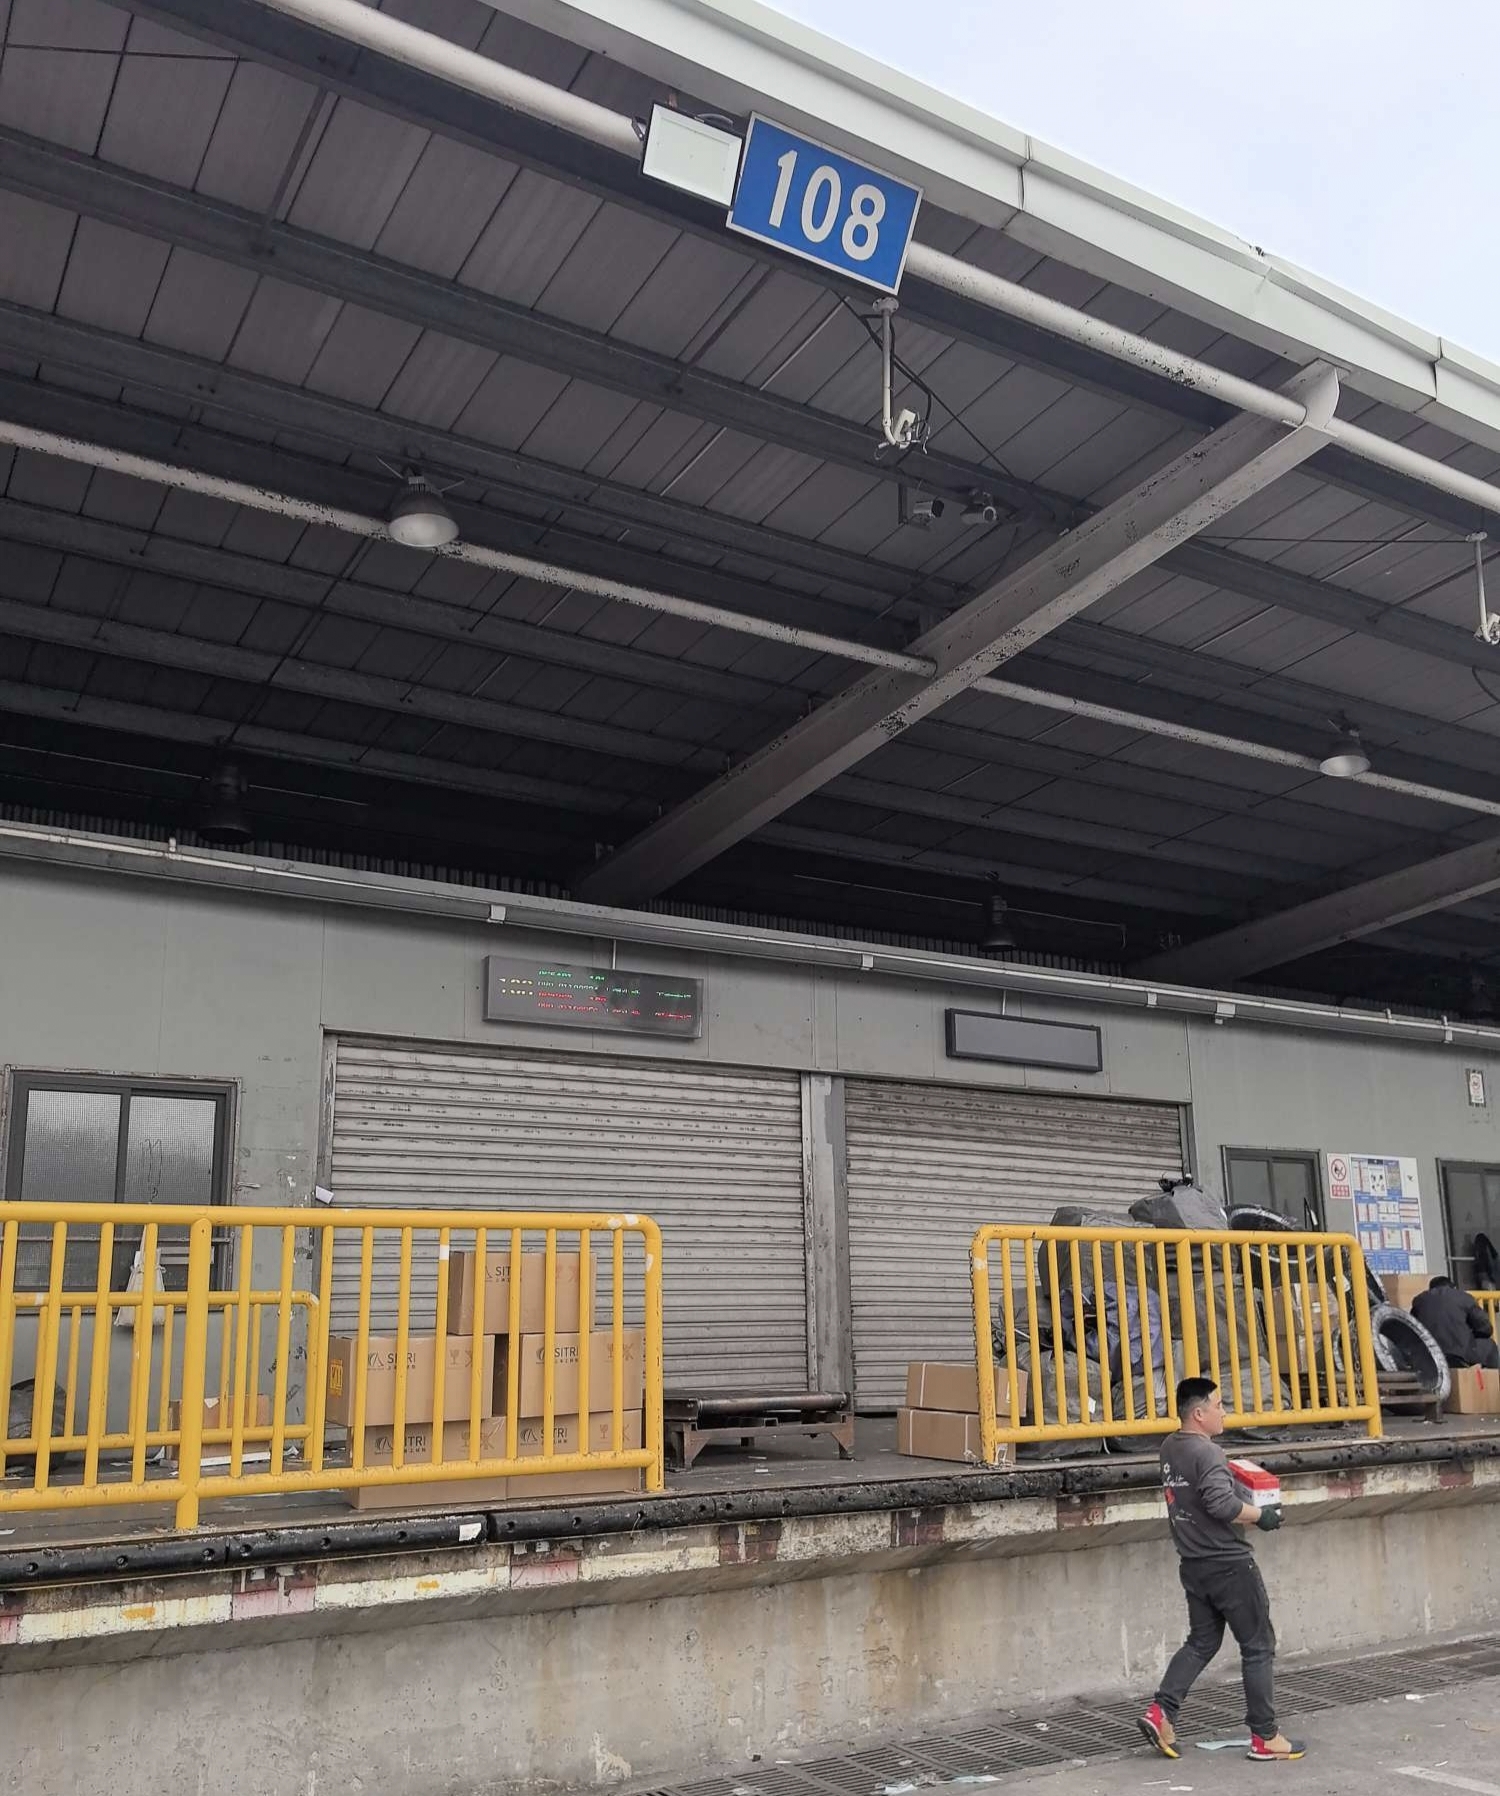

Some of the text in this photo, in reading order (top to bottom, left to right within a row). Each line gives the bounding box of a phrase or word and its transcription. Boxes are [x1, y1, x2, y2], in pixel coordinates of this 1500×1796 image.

[768, 150, 886, 261] 108
[554, 1346, 579, 1357] SITRI
[387, 1353, 416, 1364] SIRI
[404, 1436, 426, 1447] ITRI
